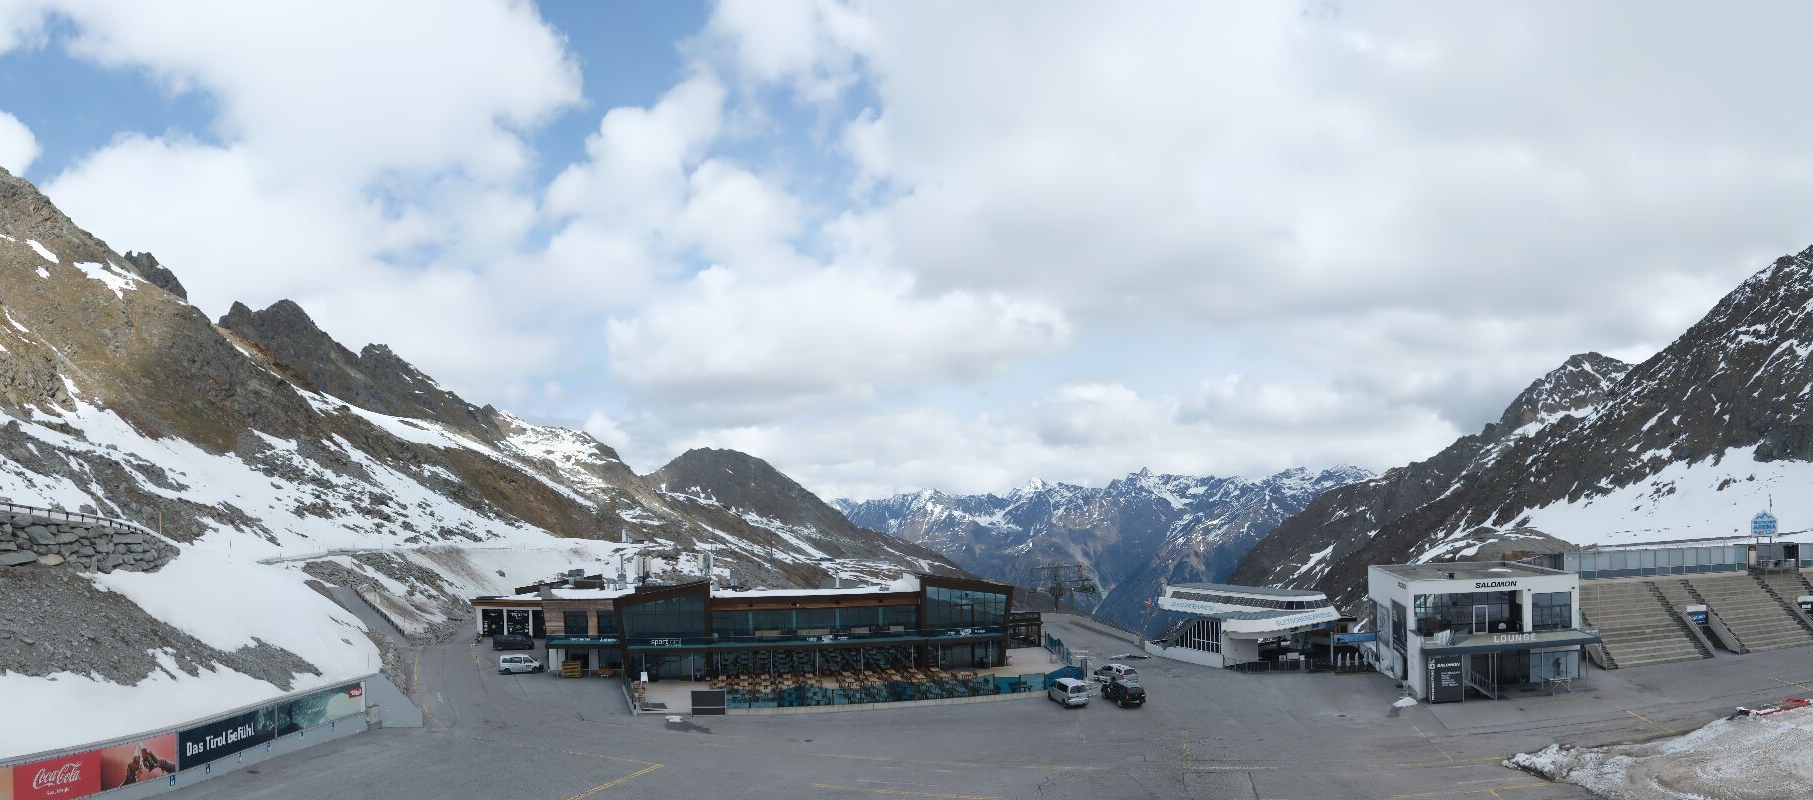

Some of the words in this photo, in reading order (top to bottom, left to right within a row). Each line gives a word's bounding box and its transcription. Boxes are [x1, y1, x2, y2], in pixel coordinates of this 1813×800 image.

[1475, 581, 1517, 589] SALOMON
[1493, 633, 1537, 643] LOUNGE
[186, 741, 204, 757] Das
[205, 731, 226, 751] Tirol
[227, 722, 255, 744] Gefühl
